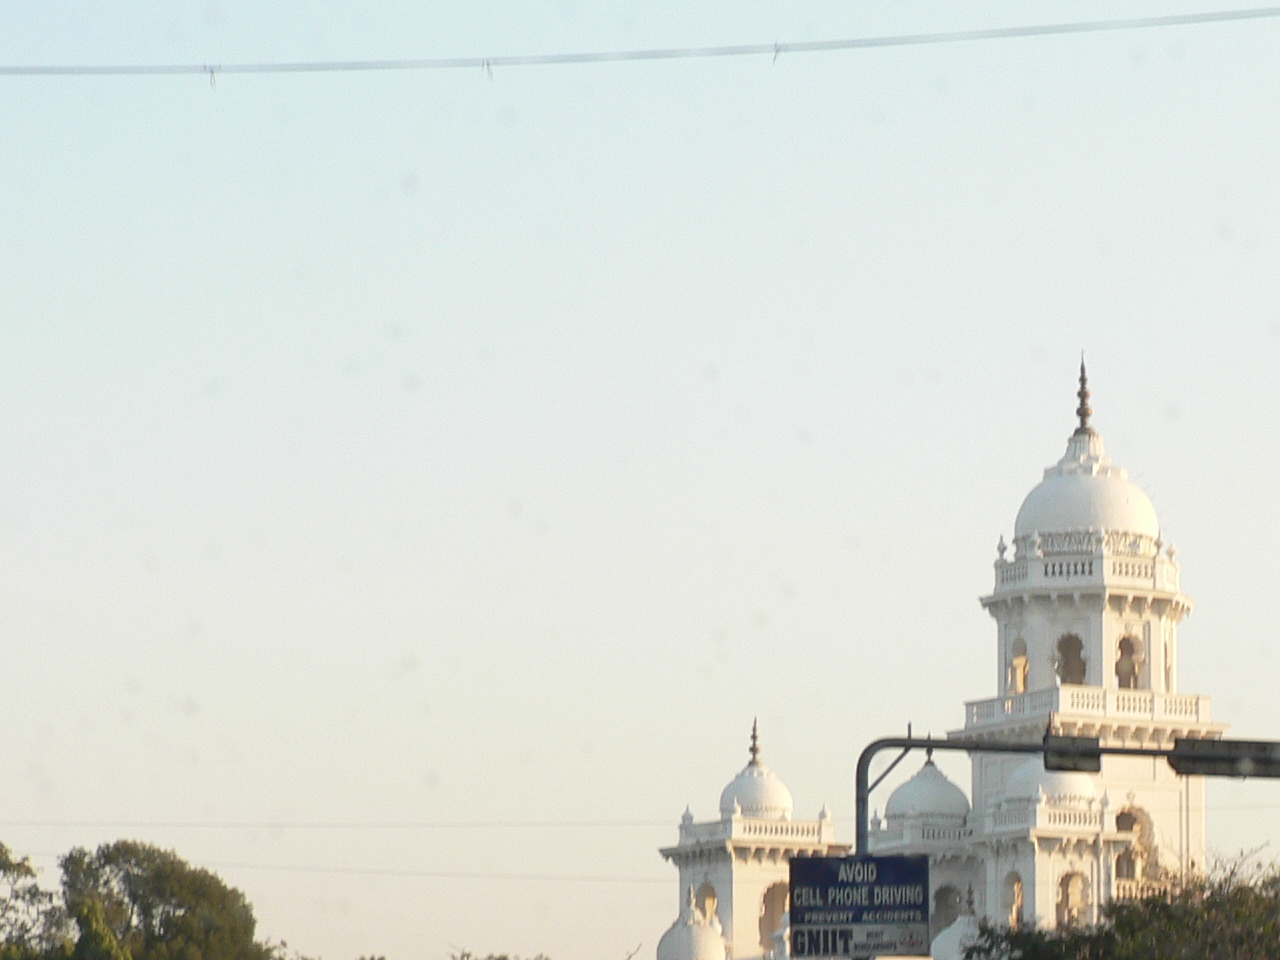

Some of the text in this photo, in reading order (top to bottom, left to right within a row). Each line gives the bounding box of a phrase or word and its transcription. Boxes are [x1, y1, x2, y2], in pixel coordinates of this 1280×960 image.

[838, 862, 877, 883] AVOID
[793, 884, 924, 907] CELL PHONE DRIVING
[804, 909, 922, 923] PREVENT ACCIDENTS
